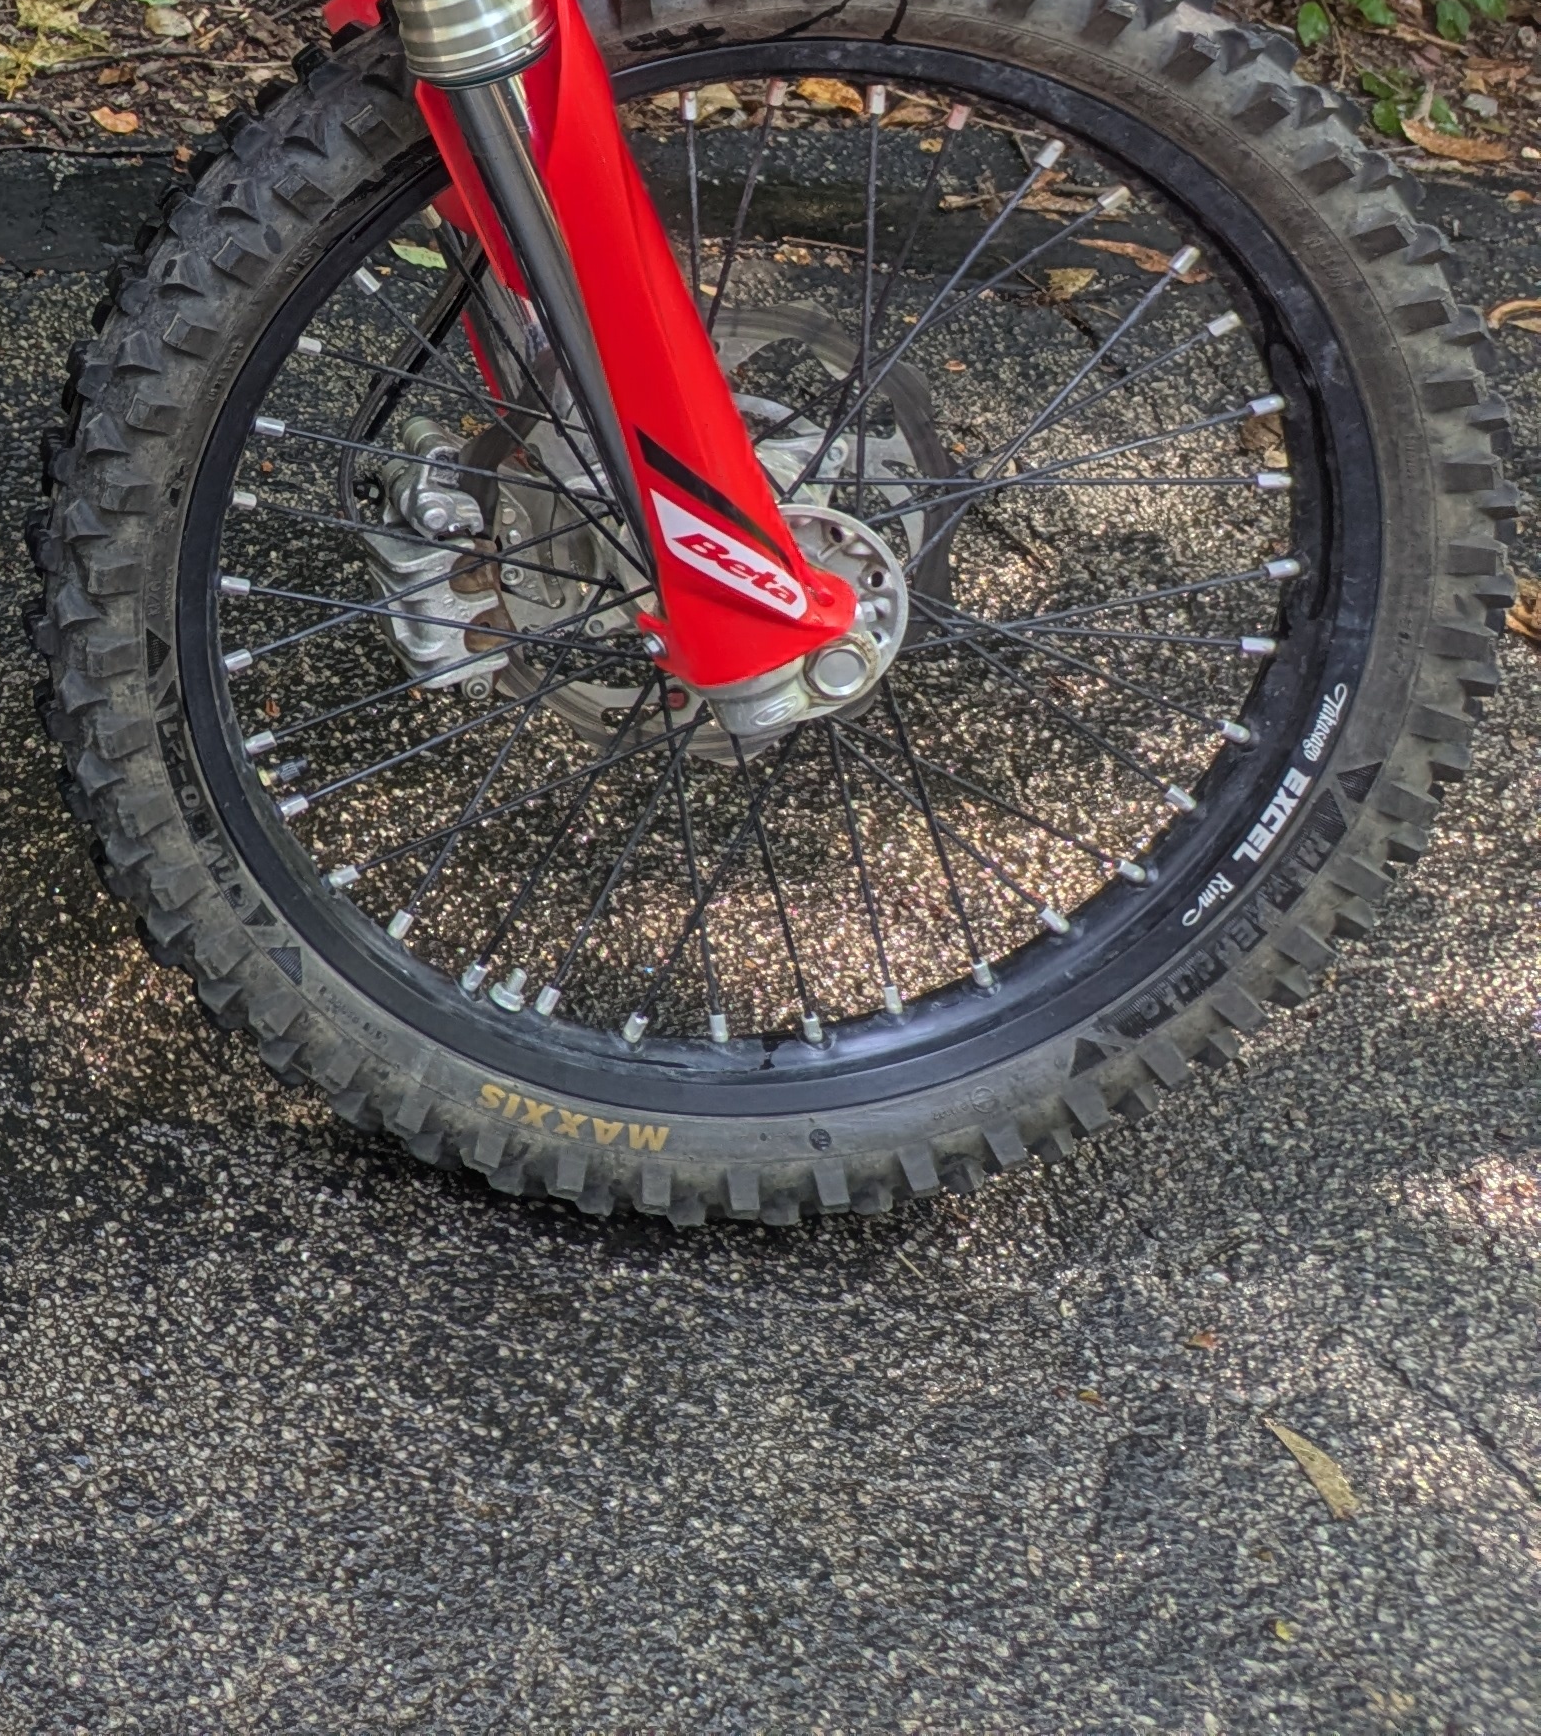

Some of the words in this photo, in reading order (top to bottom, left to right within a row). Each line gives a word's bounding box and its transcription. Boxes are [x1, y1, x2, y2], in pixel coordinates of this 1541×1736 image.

[670, 532, 799, 606] Beta
[1303, 682, 1348, 762] Takasago
[1232, 766, 1313, 864] EXCEL
[1181, 871, 1237, 927] Rim
[475, 1082, 671, 1152] MAXXIS
